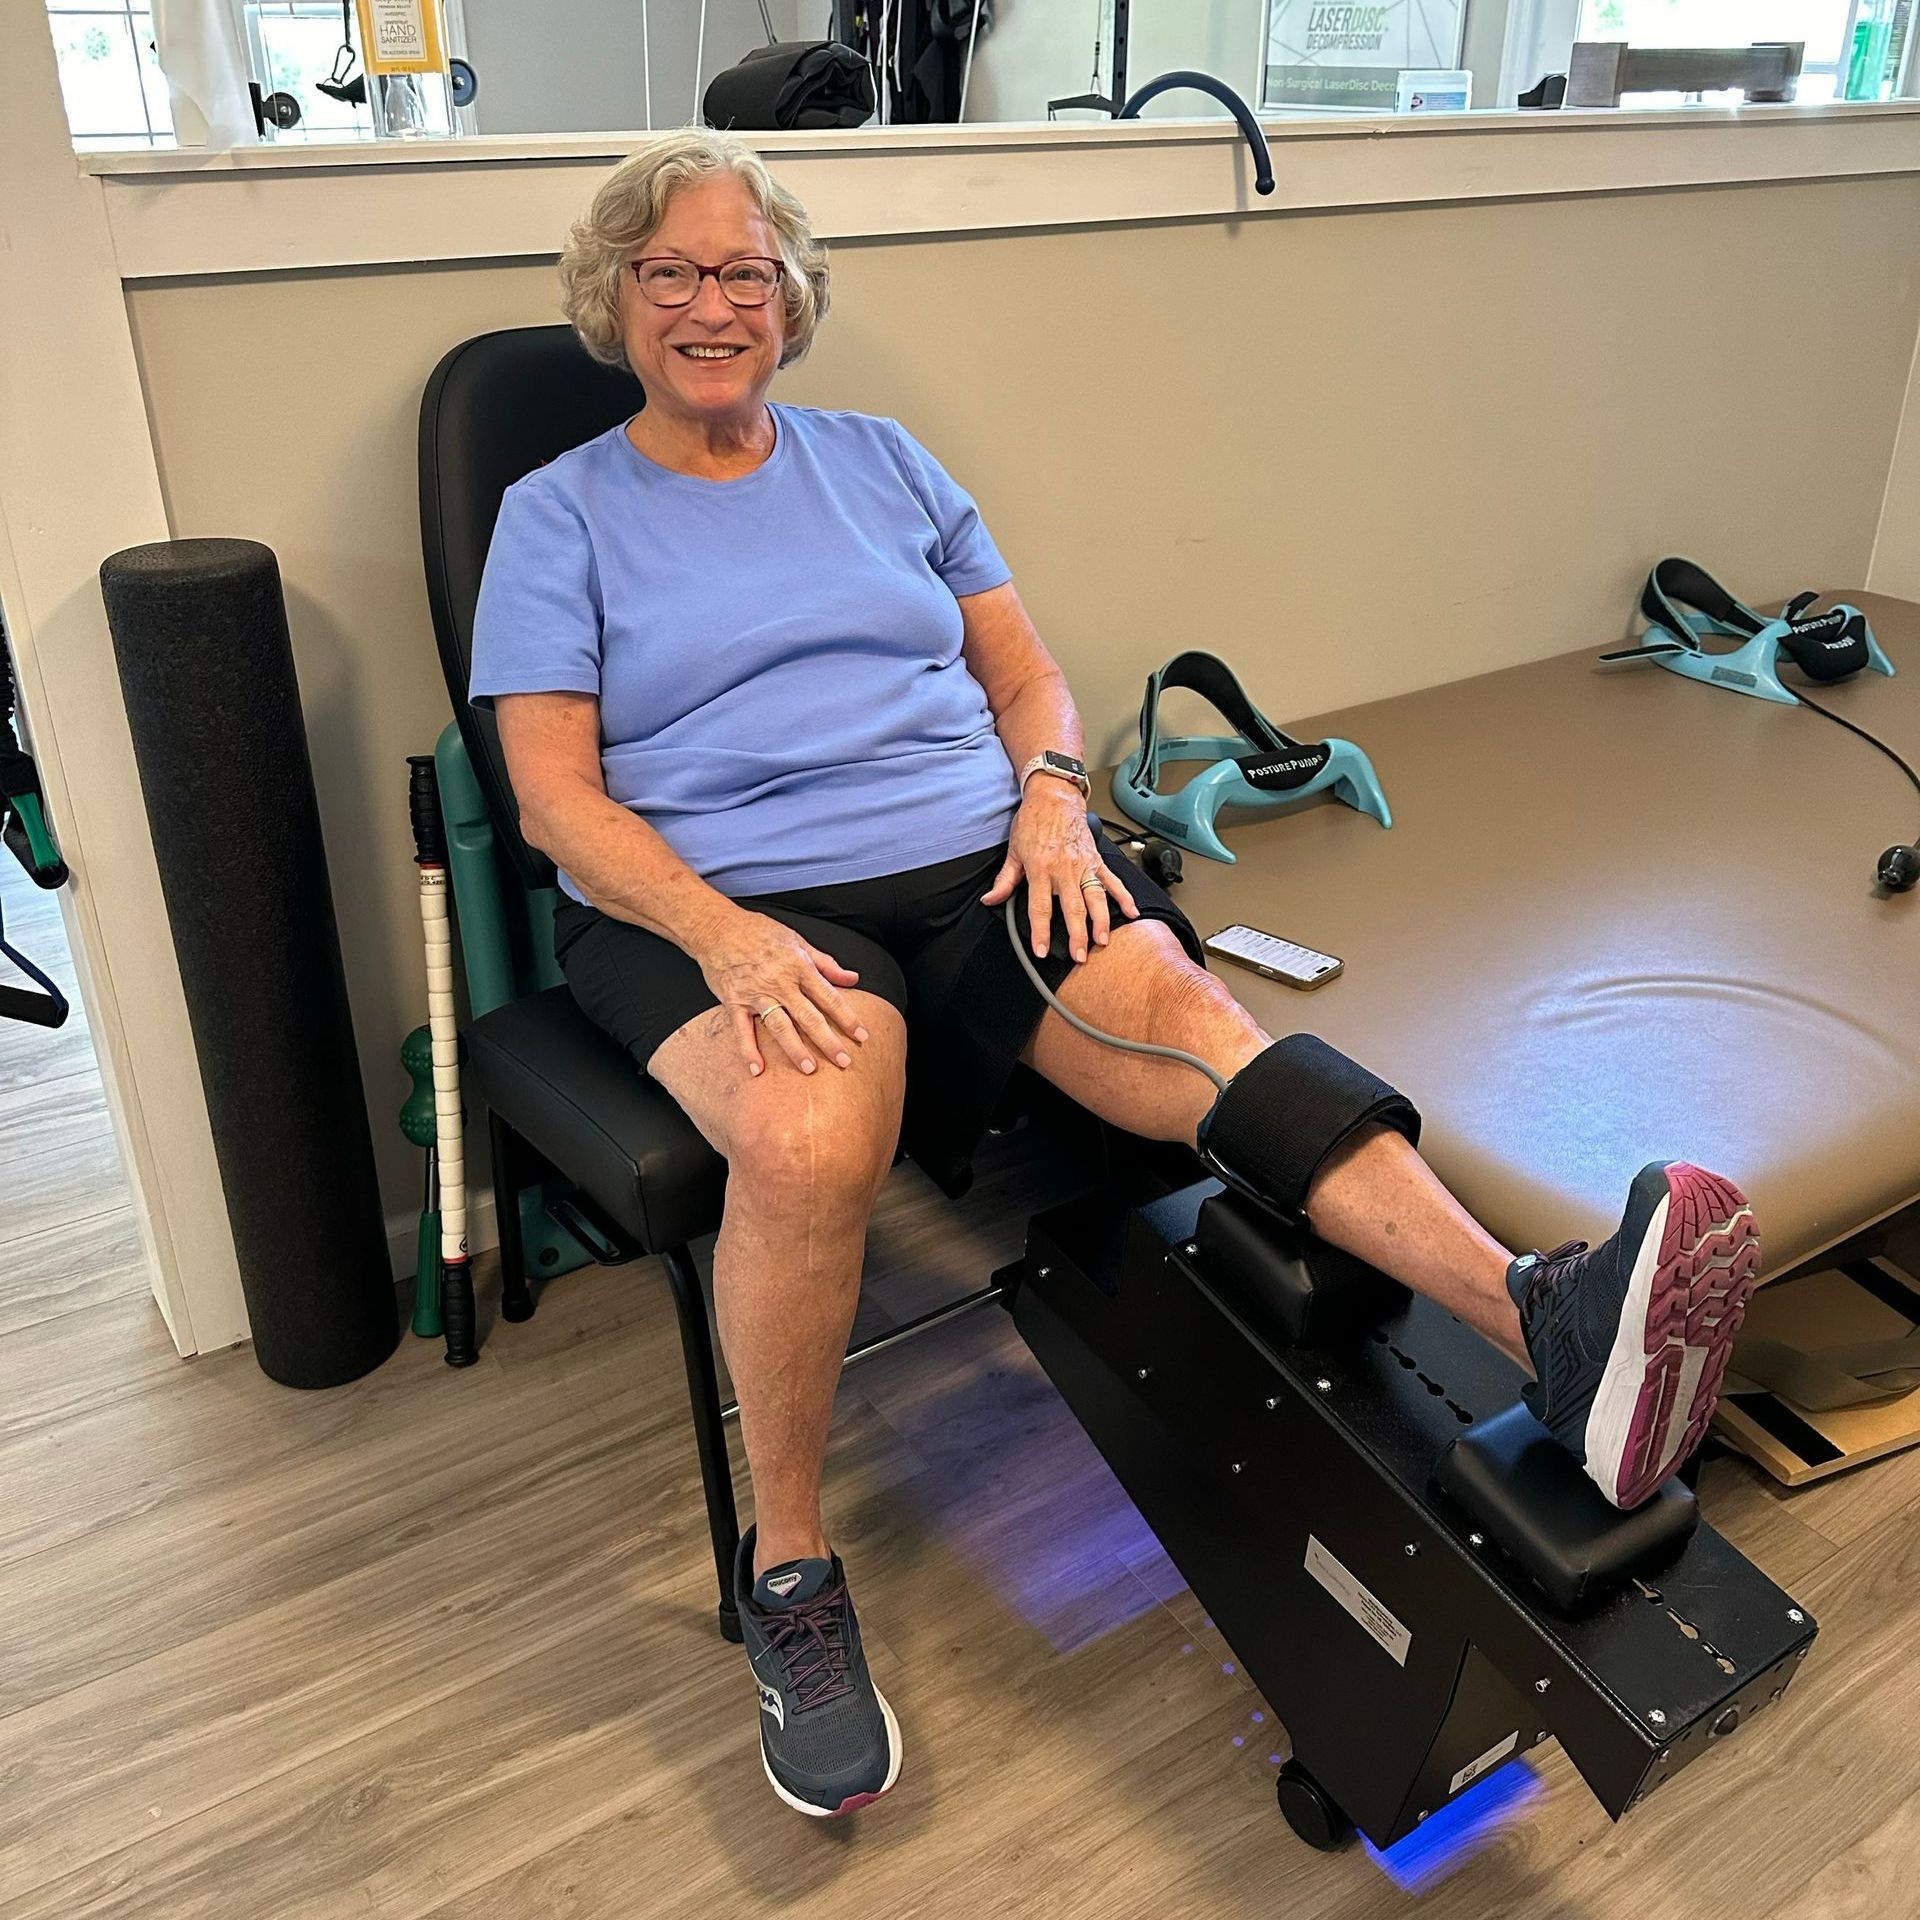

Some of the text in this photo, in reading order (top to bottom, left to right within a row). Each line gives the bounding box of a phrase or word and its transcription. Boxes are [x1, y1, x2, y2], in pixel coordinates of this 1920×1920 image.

[1307, 6, 1386, 33] LASERDISC
[380, 24, 416, 36] HAND
[381, 36, 417, 44] SANITIZER
[1306, 33, 1383, 51] DECOMPRESSION
[1324, 78, 1370, 91] LaserDisc
